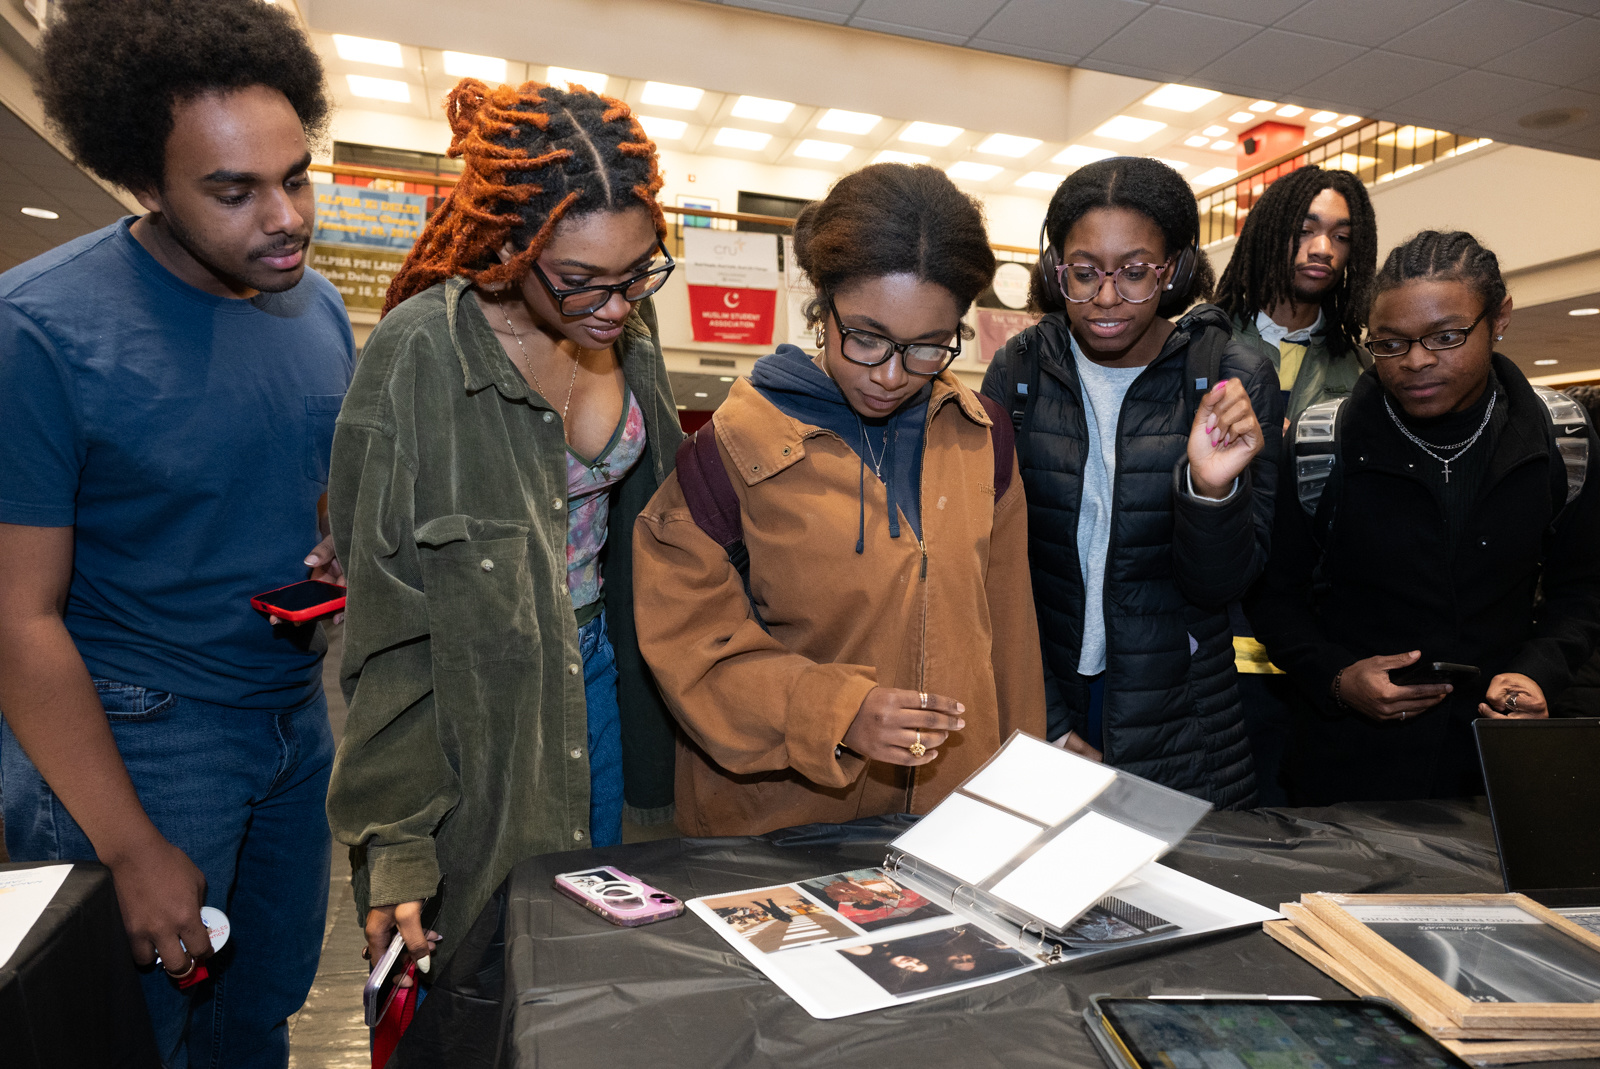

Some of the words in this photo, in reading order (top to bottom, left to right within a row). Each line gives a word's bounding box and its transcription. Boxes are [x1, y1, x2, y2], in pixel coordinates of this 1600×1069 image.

[318, 195, 361, 207] ALPHA
[381, 202, 420, 214] DELTA
[379, 214, 419, 227] Chapter
[318, 220, 367, 236] January
[314, 255, 351, 267] ALPHA
[353, 258, 372, 269] PSI
[347, 271, 375, 283] Delta
[702, 311, 729, 319] MUSLIM
[730, 312, 761, 321] STUDENT
[709, 320, 755, 328] ASSOCIATION
